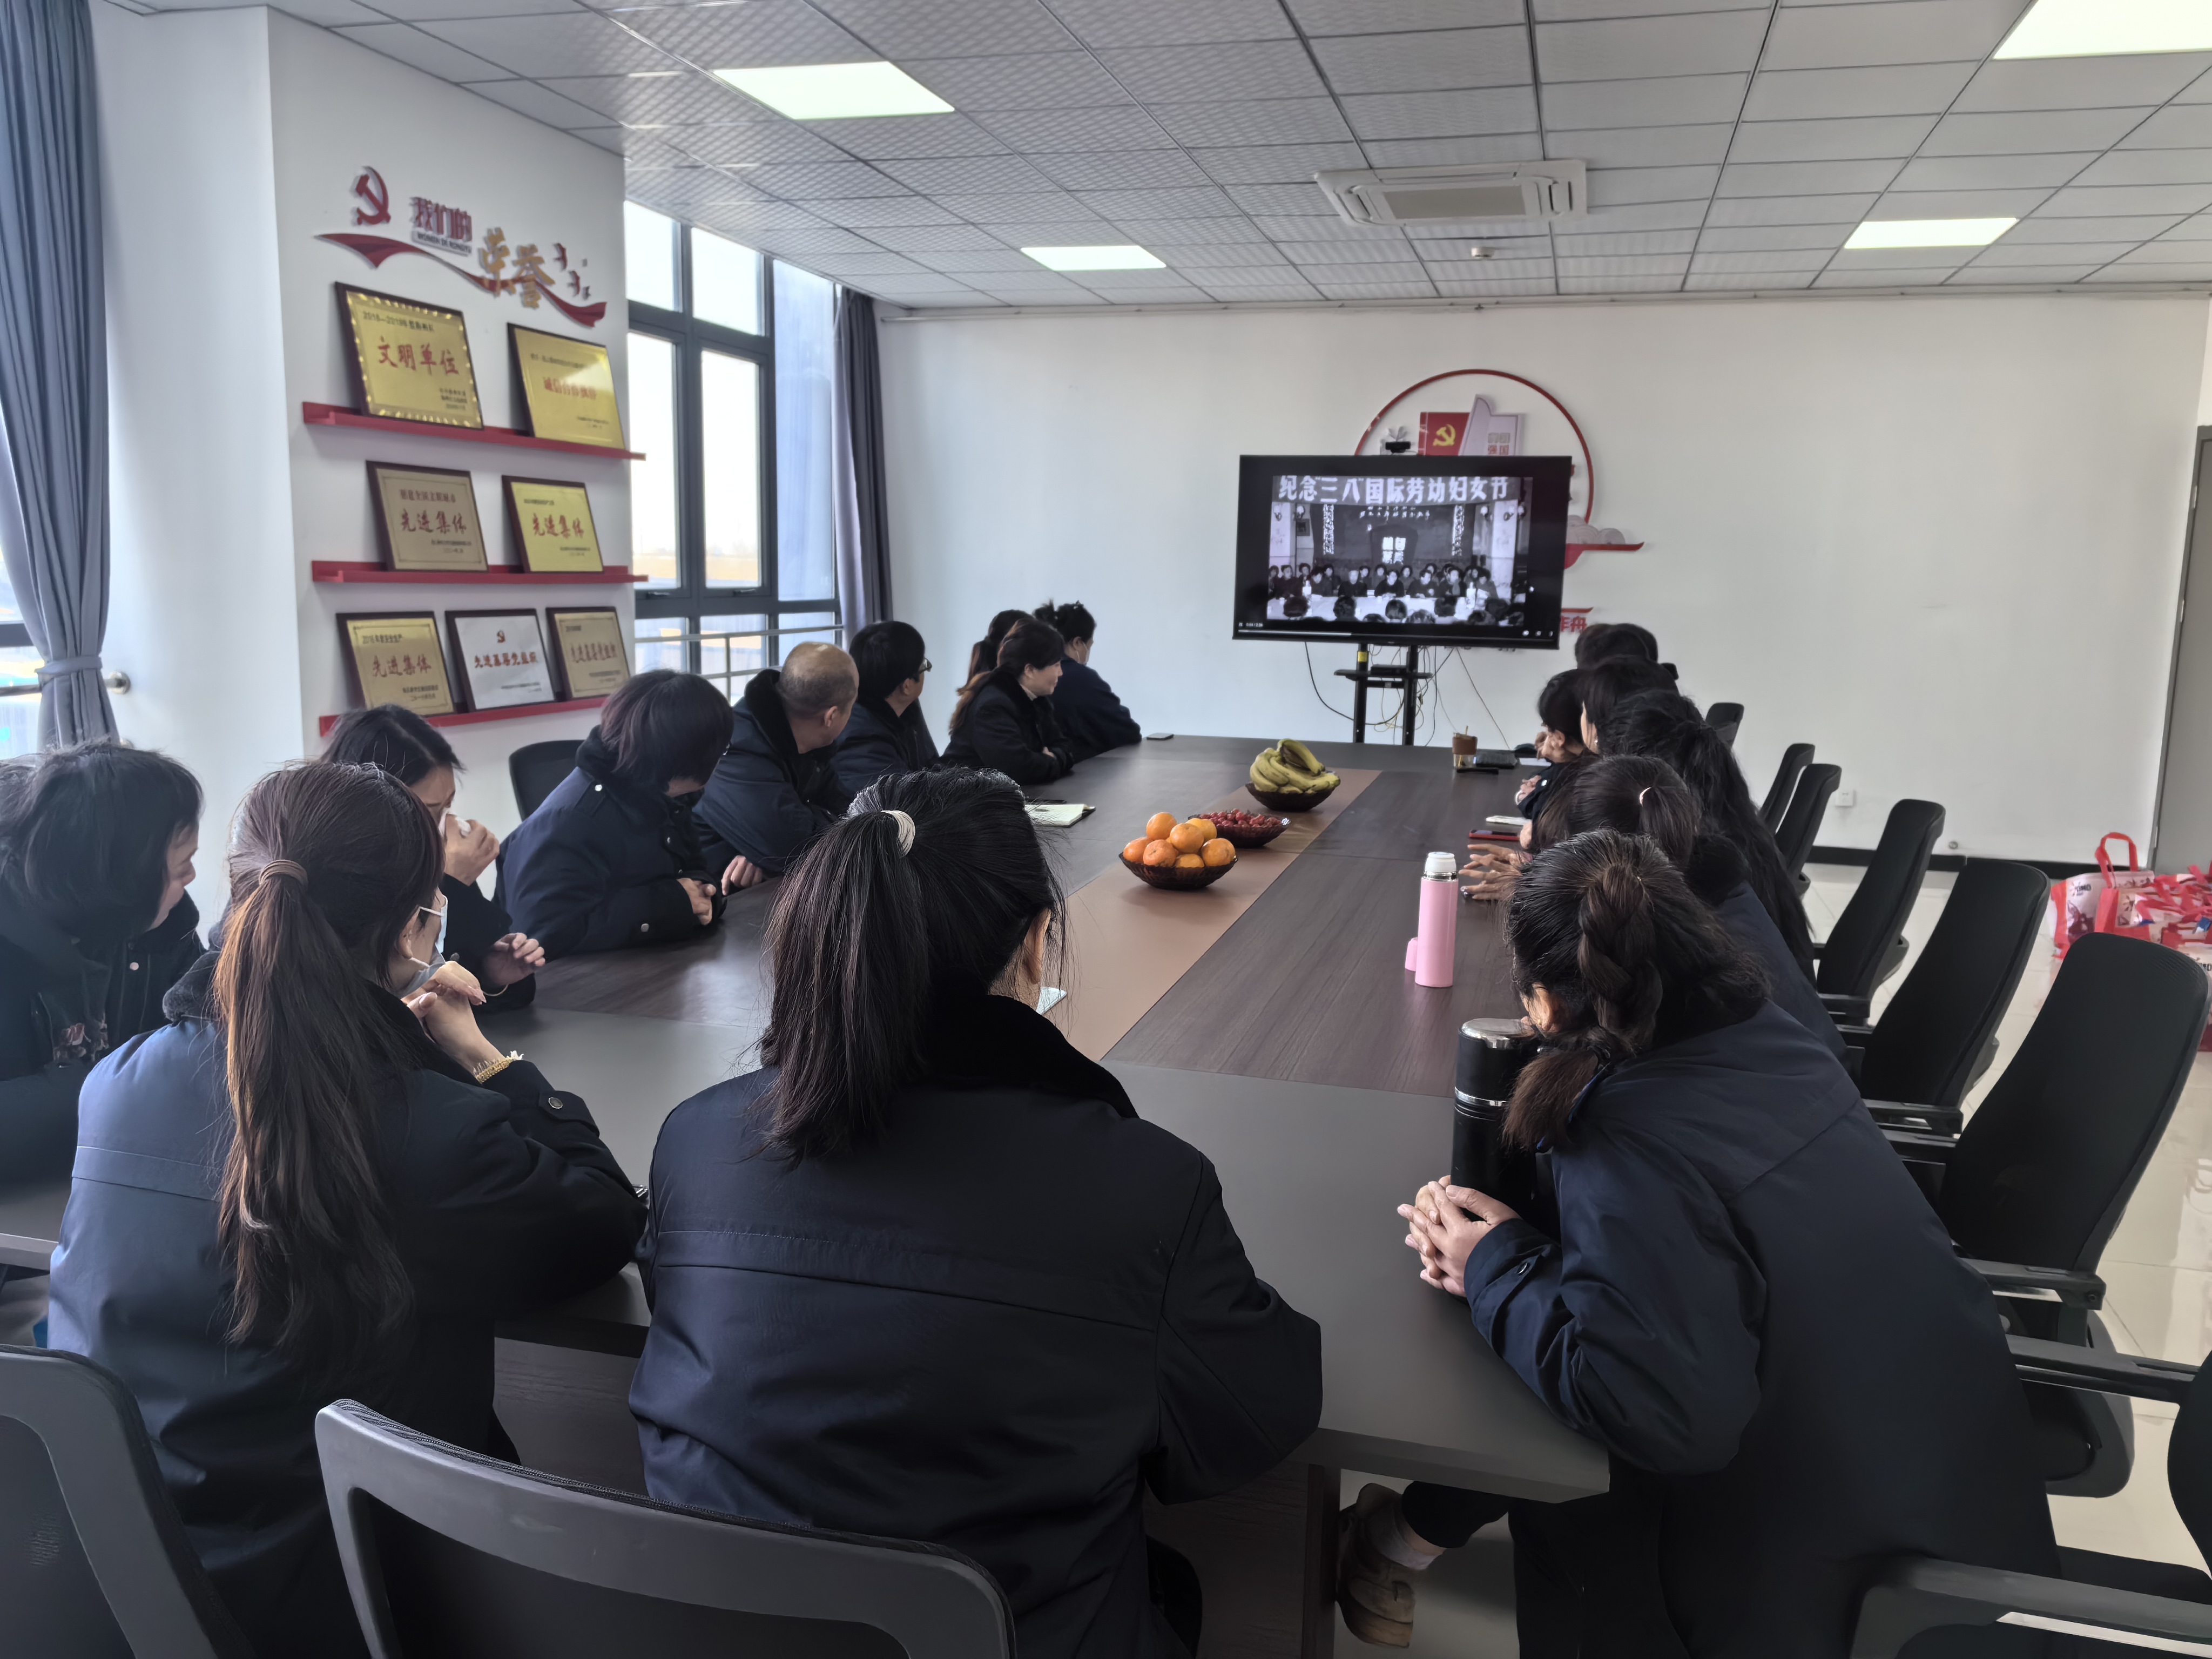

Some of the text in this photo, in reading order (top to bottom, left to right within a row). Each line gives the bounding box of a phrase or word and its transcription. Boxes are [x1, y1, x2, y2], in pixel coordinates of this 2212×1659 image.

[410, 197, 473, 241] 我们的
[479, 227, 556, 308] 荣誉
[377, 335, 460, 376] 文明单位
[401, 508, 467, 535] 先进集体
[532, 512, 584, 539] 先进集体
[373, 653, 432, 678] 先进集体
